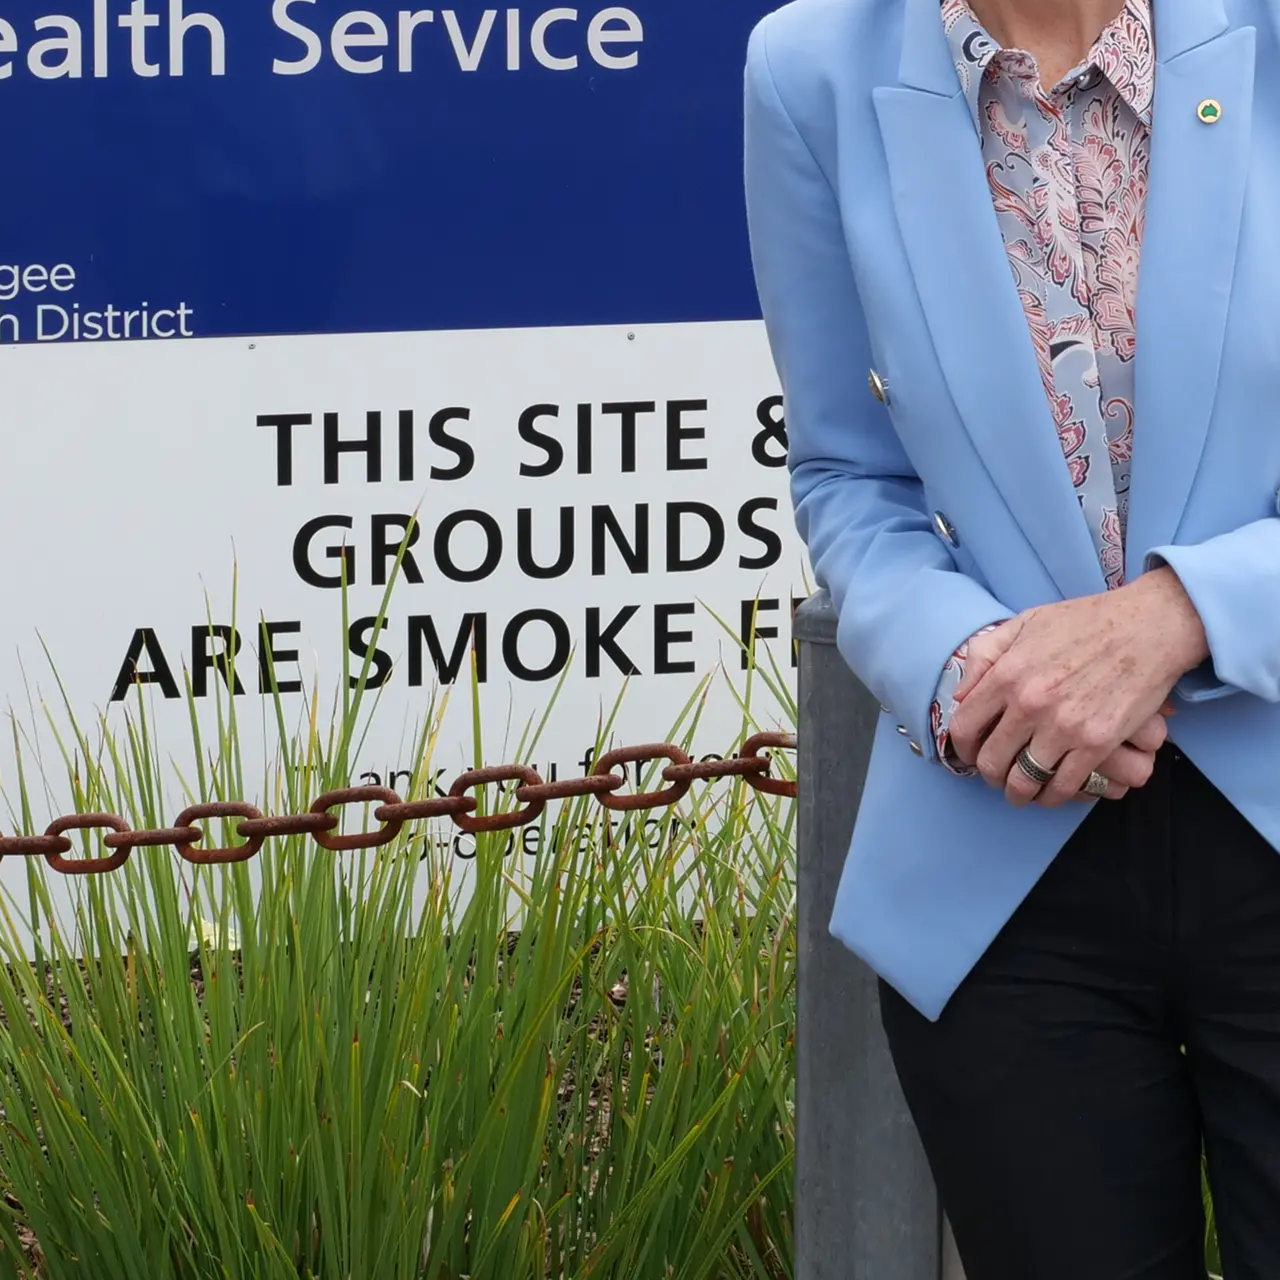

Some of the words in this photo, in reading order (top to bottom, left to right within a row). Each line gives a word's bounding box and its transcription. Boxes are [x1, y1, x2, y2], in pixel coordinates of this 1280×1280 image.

[36, 301, 194, 341] District
[257, 408, 474, 486] THIS
[518, 400, 707, 477] SITE
[293, 497, 782, 589] GROUNDS
[111, 622, 301, 701] ARE
[348, 603, 695, 690] SMOKE
